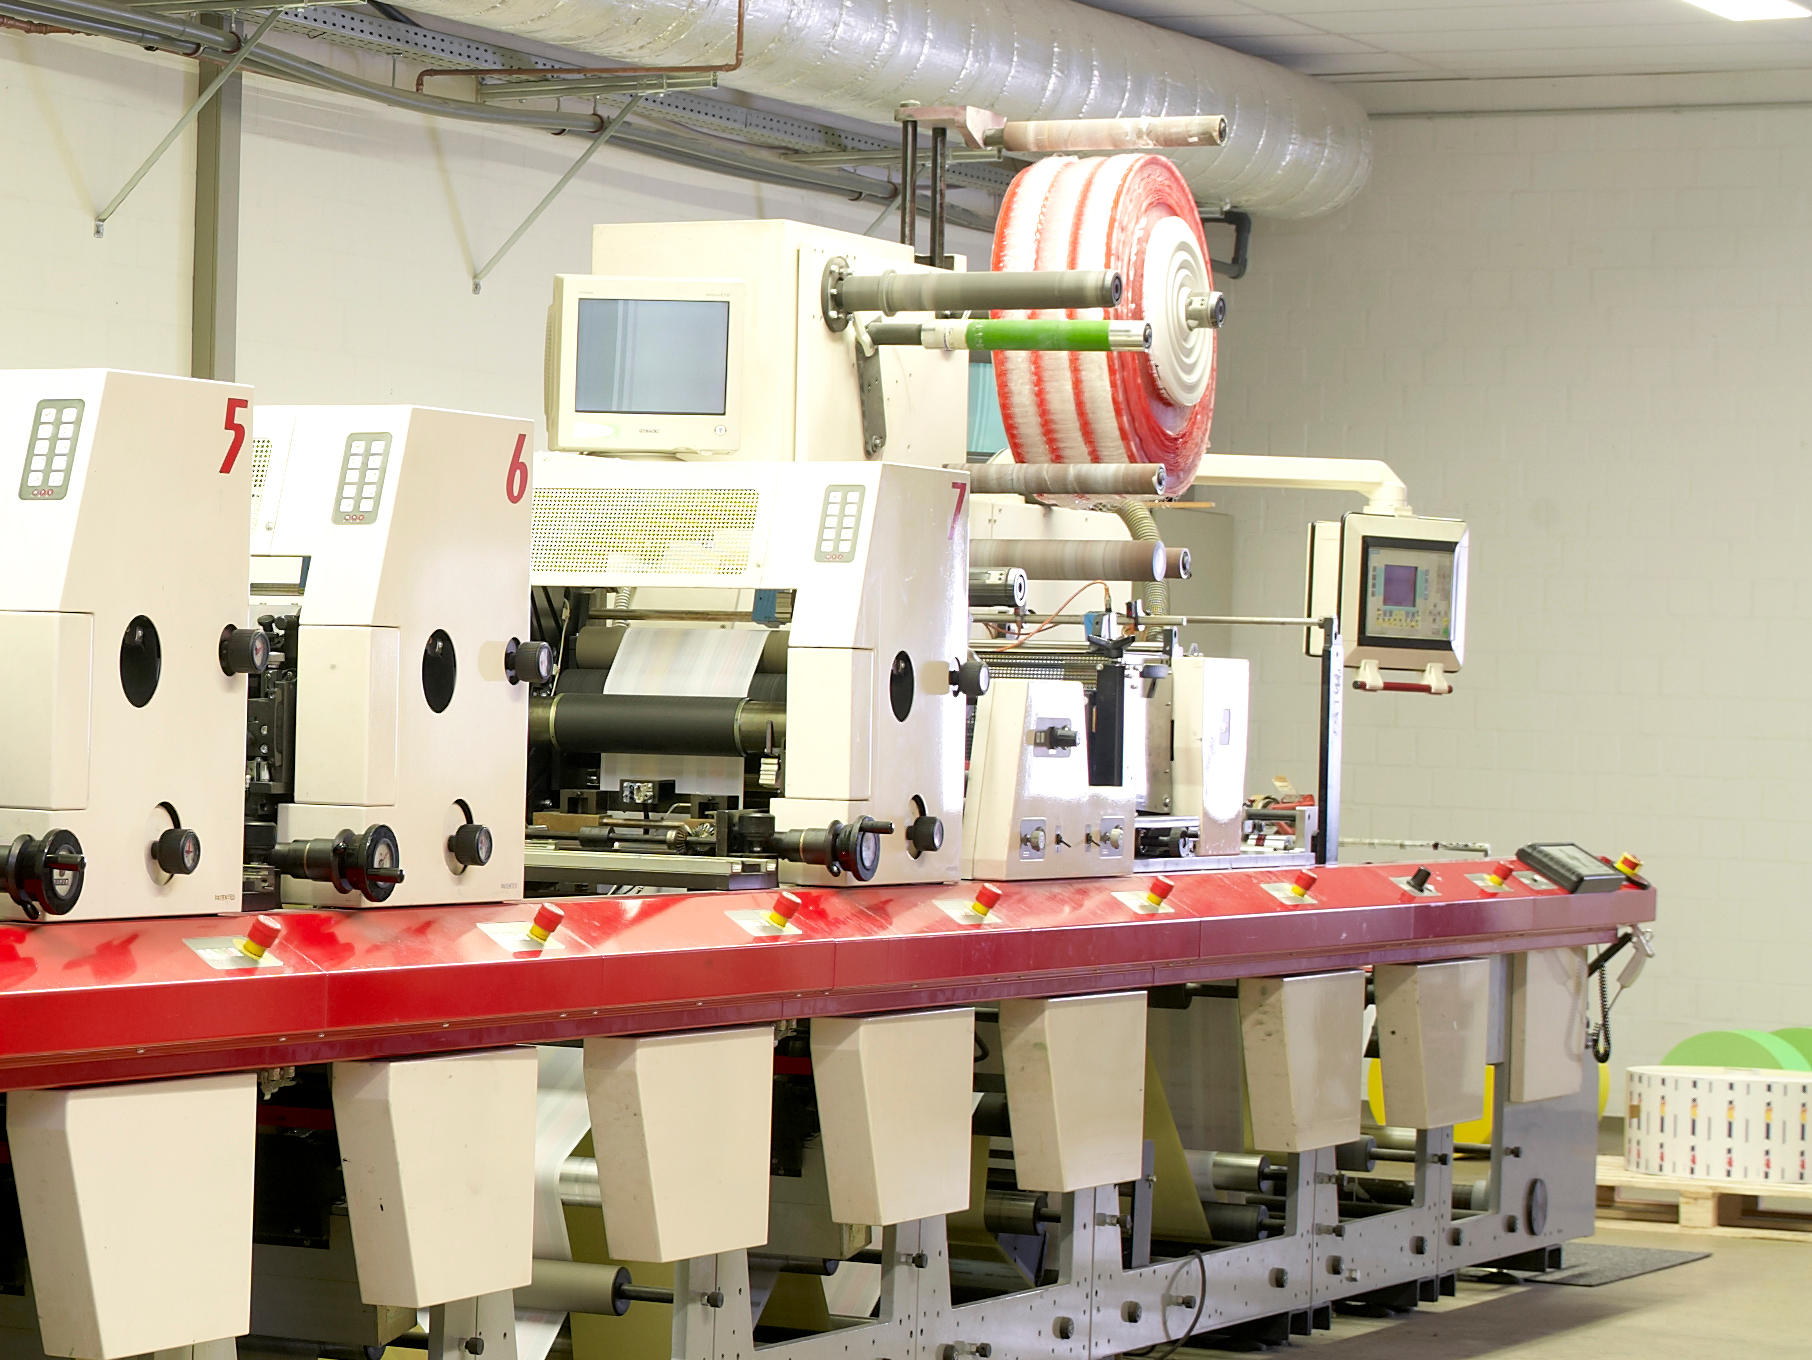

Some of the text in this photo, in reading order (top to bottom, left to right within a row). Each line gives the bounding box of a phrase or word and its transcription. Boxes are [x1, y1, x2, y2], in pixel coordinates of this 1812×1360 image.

[219, 397, 249, 475] 5
[505, 433, 529, 505] 6
[948, 481, 968, 540] 7
